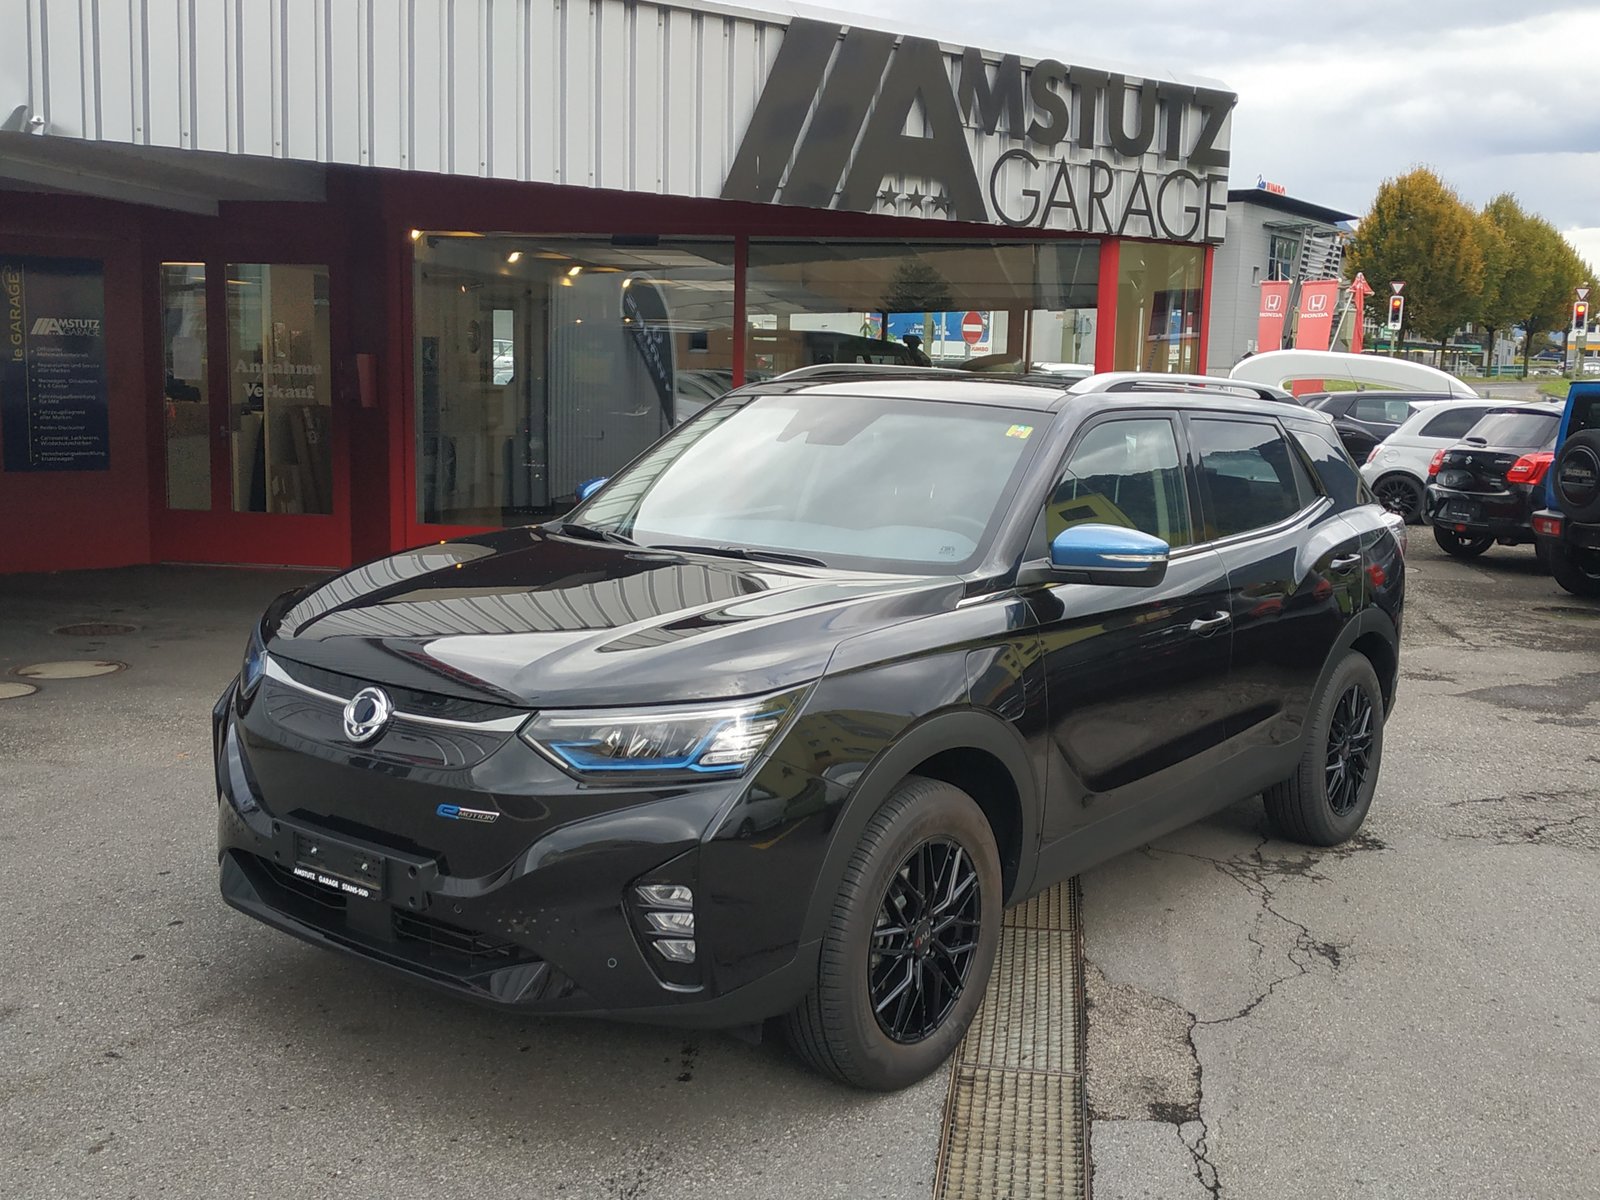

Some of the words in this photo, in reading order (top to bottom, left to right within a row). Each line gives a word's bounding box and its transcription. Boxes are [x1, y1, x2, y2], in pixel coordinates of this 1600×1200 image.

[836, 35, 1238, 223] AMSTUTZ
[989, 148, 1229, 244] GARAGE
[9, 273, 22, 344] GARAGE
[63, 327, 101, 336] GARAGE
[12, 350, 23, 362] le
[293, 867, 316, 881] AMSTUTZ
[318, 875, 339, 889] GARAGE
